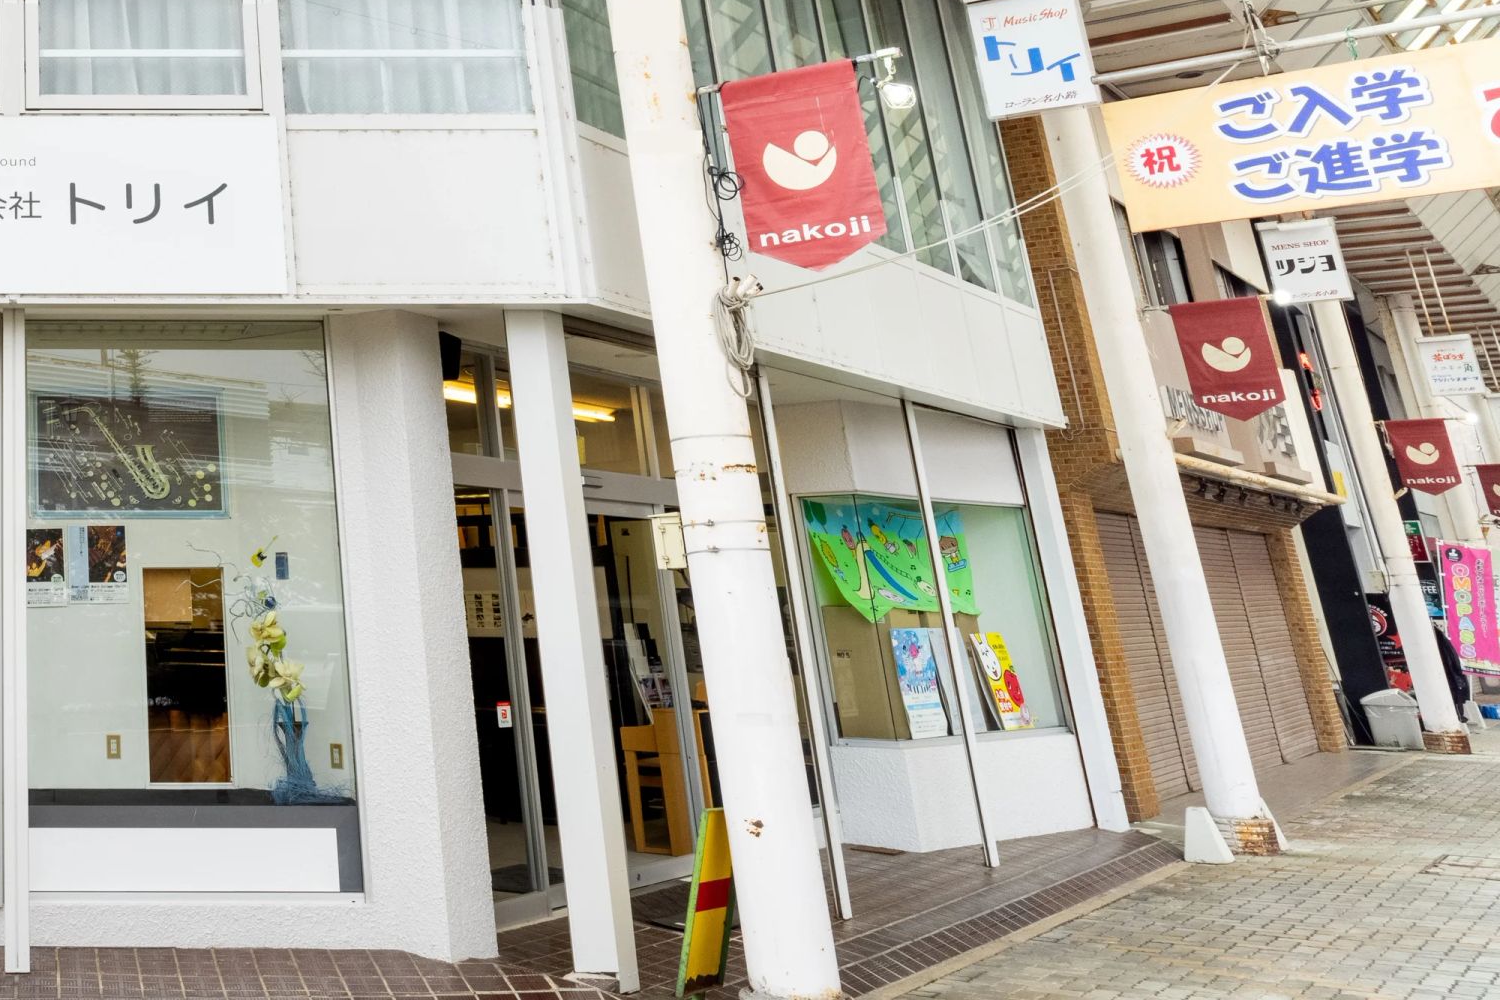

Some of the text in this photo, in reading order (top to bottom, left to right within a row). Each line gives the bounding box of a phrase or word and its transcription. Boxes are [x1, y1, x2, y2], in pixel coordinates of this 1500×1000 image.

[1003, 13, 1037, 28] Music
[1039, 6, 1068, 22] Shop
[983, 35, 1081, 83] トリイ
[1217, 68, 1425, 140] ご入学
[1140, 144, 1182, 176] 祝
[1233, 130, 1445, 199] ご進学
[68, 182, 229, 226] トリイ
[760, 215, 871, 247] nakoji
[1271, 239, 1330, 252] MENS SHOP
[1291, 289, 1339, 299] ーラン名小路
[1202, 388, 1278, 404] nakoji
[1406, 475, 1456, 485] nakoji
[1451, 563, 1477, 659] OMOPASS
